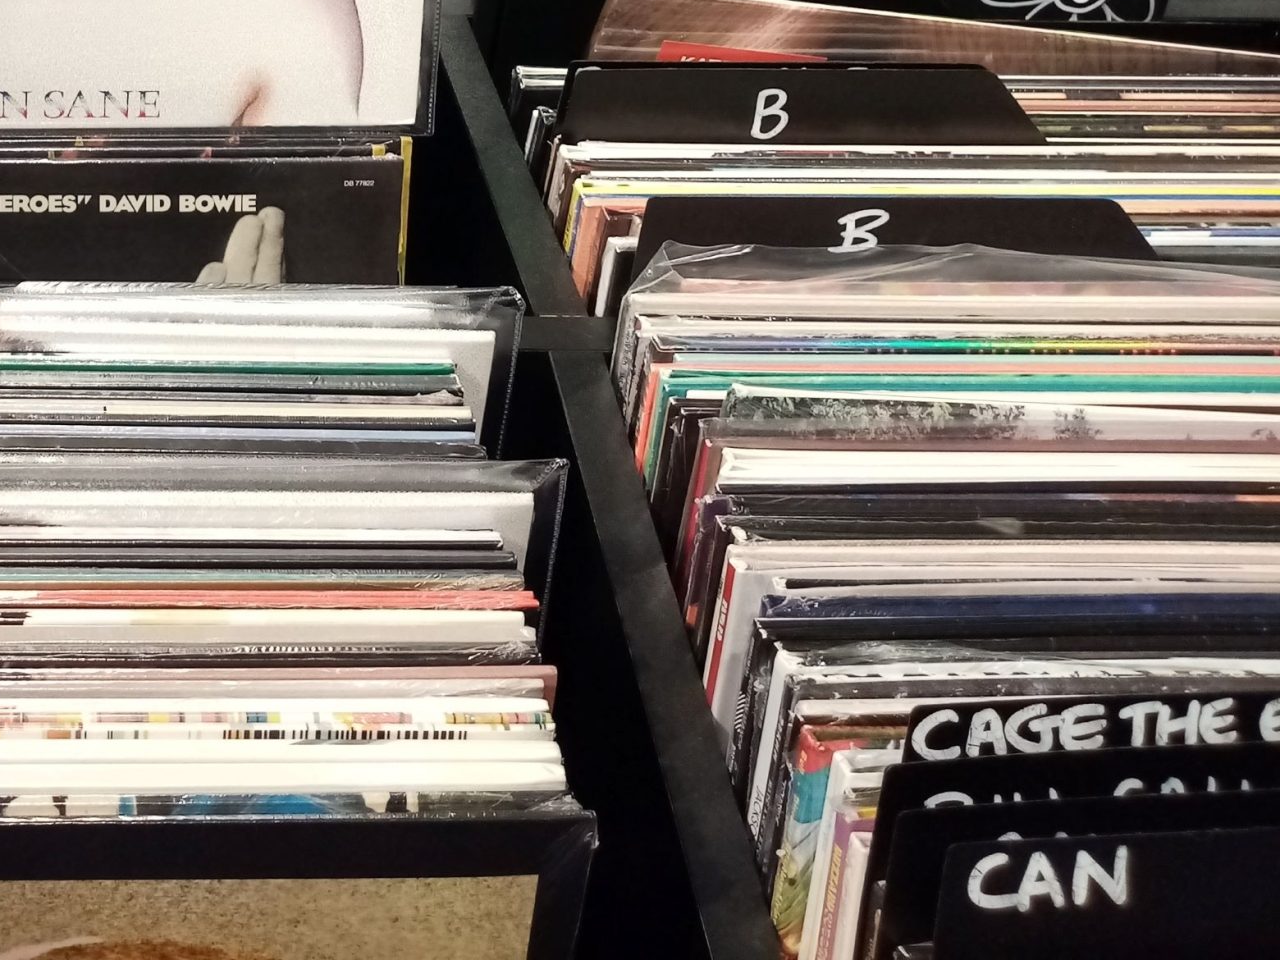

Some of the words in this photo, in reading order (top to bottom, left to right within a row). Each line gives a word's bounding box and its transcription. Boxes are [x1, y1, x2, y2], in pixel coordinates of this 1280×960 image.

[42, 89, 161, 119] SANE
[751, 88, 789, 140] B
[99, 195, 171, 213] DAVID
[179, 194, 257, 213] BOWIE
[827, 208, 890, 253] B
[911, 703, 1108, 761] CAGE
[1118, 697, 1238, 748] THE
[967, 844, 1128, 912] CAN
